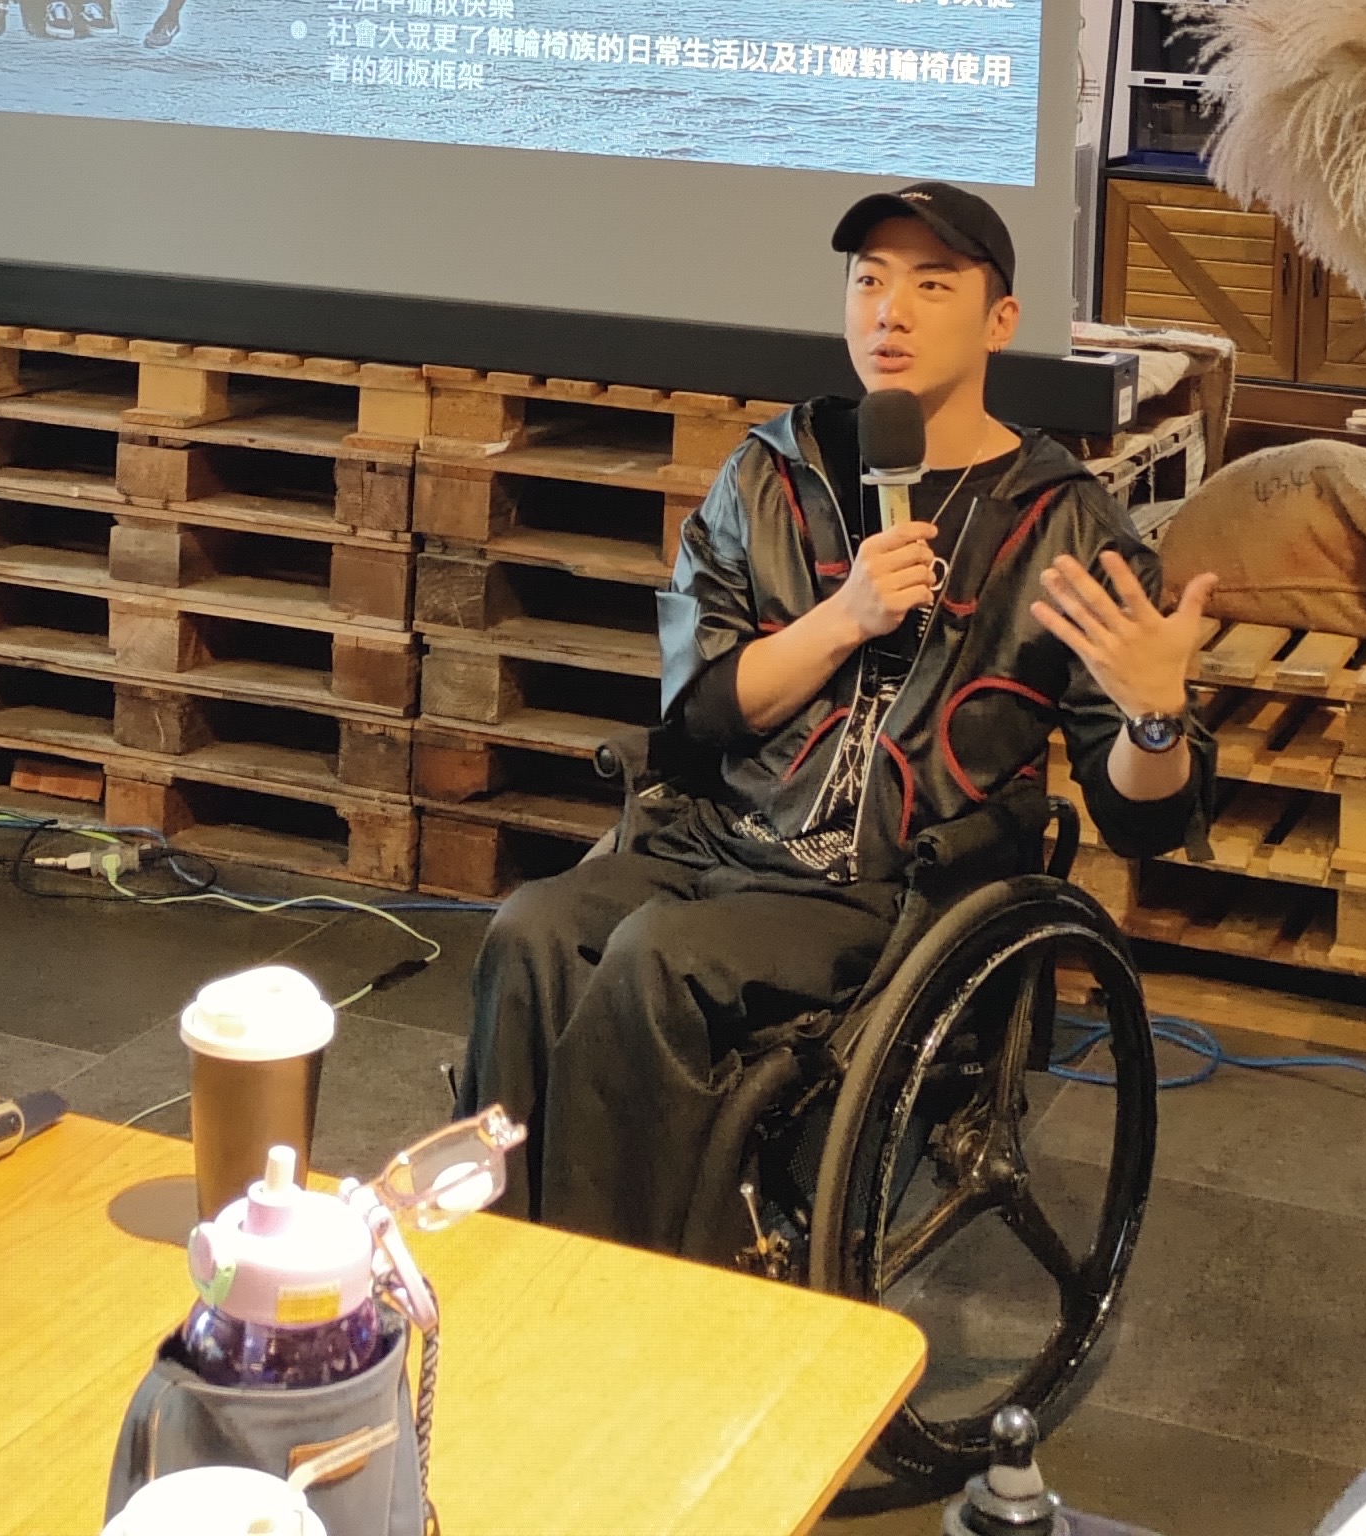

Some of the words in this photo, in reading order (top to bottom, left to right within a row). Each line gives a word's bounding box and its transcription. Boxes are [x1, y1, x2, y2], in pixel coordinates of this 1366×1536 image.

[325, 54, 485, 91] 者的刻板框架
[326, 17, 1011, 87] 社會大眾更了解輪椅族的日常生活以及打破對輪椅使用
